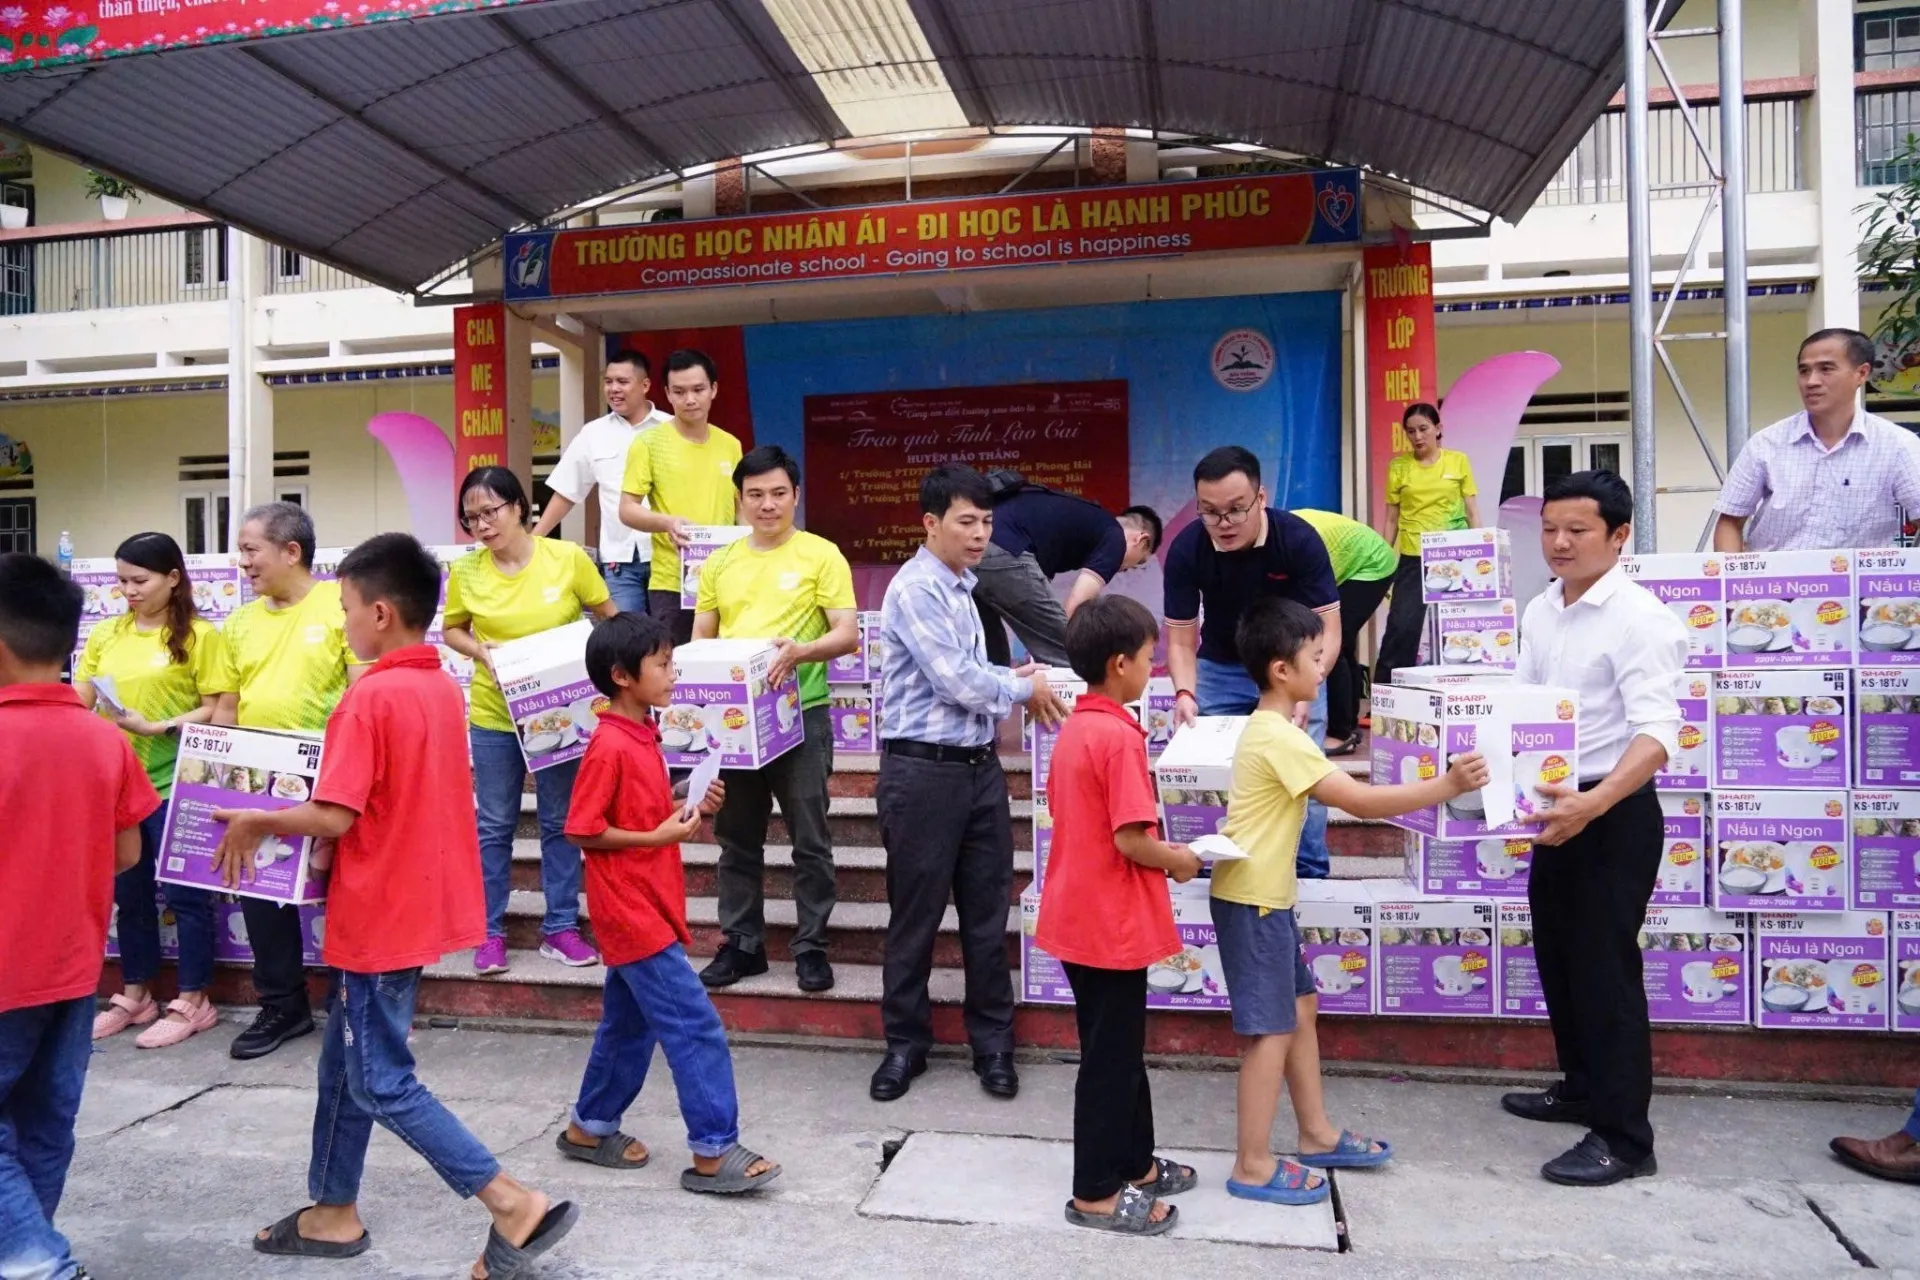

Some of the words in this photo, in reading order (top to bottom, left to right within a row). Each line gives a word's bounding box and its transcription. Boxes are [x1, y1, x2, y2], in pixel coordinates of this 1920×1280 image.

[574, 230, 685, 266] TRƯỜNG
[695, 228, 753, 261] HỌC
[763, 217, 846, 252] NHÂN
[856, 213, 886, 246] ÁI
[896, 227, 908, 235] -
[917, 212, 948, 241] ĐI
[959, 206, 1021, 242] HỌC
[1032, 197, 1070, 232] LÀ
[1081, 195, 1170, 233] HẠNH
[1182, 184, 1270, 221] PHÚC
[641, 260, 793, 284] Compassionate
[799, 254, 865, 273] school
[886, 249, 949, 268] Going
[954, 245, 976, 262] to
[981, 241, 1052, 260] school
[1058, 239, 1073, 255] is
[1079, 232, 1192, 255] happiness
[1370, 258, 1429, 298] TRƯỜNG
[467, 319, 495, 346] CHA
[1387, 308, 1416, 349] LỚP
[471, 364, 493, 396] MẸ
[462, 404, 503, 437] CHĂM
[848, 428, 898, 449] Trao
[903, 430, 940, 453] quà
[1859, 558, 1906, 568] KS-18TJV
[1660, 585, 1701, 598] Ngon
[1732, 581, 1764, 595] Nấu
[1768, 582, 1782, 594] là
[1786, 582, 1829, 596] Ngon
[1869, 578, 1903, 592] Nấu
[504, 680, 541, 697] KS-18TJV
[1716, 680, 1762, 690] KS-18TJV
[1861, 678, 1909, 687] KS-18TJV
[546, 694, 560, 706] là
[561, 684, 596, 702] Ngon
[684, 688, 696, 700] là
[699, 688, 731, 702] Ngon
[1446, 694, 1486, 702] SHARP
[1446, 704, 1493, 715] KS-18TJV
[188, 726, 228, 738] SHARP
[185, 736, 233, 754] KS-18TJV
[1512, 731, 1555, 748] Ngon
[1160, 774, 1198, 784] KS-18TJV
[1717, 801, 1761, 811] KS-18TJV
[1854, 801, 1900, 811] KS-18TJV
[1664, 824, 1681, 834] on
[1727, 822, 1758, 836] Nấu
[1763, 823, 1776, 836] là
[1781, 824, 1823, 838] Ngon
[1380, 911, 1420, 921] KS-18TJV
[1501, 912, 1532, 922] KS-18T
[1643, 916, 1668, 926] 18TJV
[1760, 920, 1804, 929] KS-18TJV
[1897, 920, 1920, 930] KS-1
[1183, 928, 1195, 940] là
[1198, 929, 1218, 942] Ng
[1769, 940, 1801, 954] Nấu
[1805, 942, 1818, 954] là
[1823, 943, 1864, 957] Ngon
